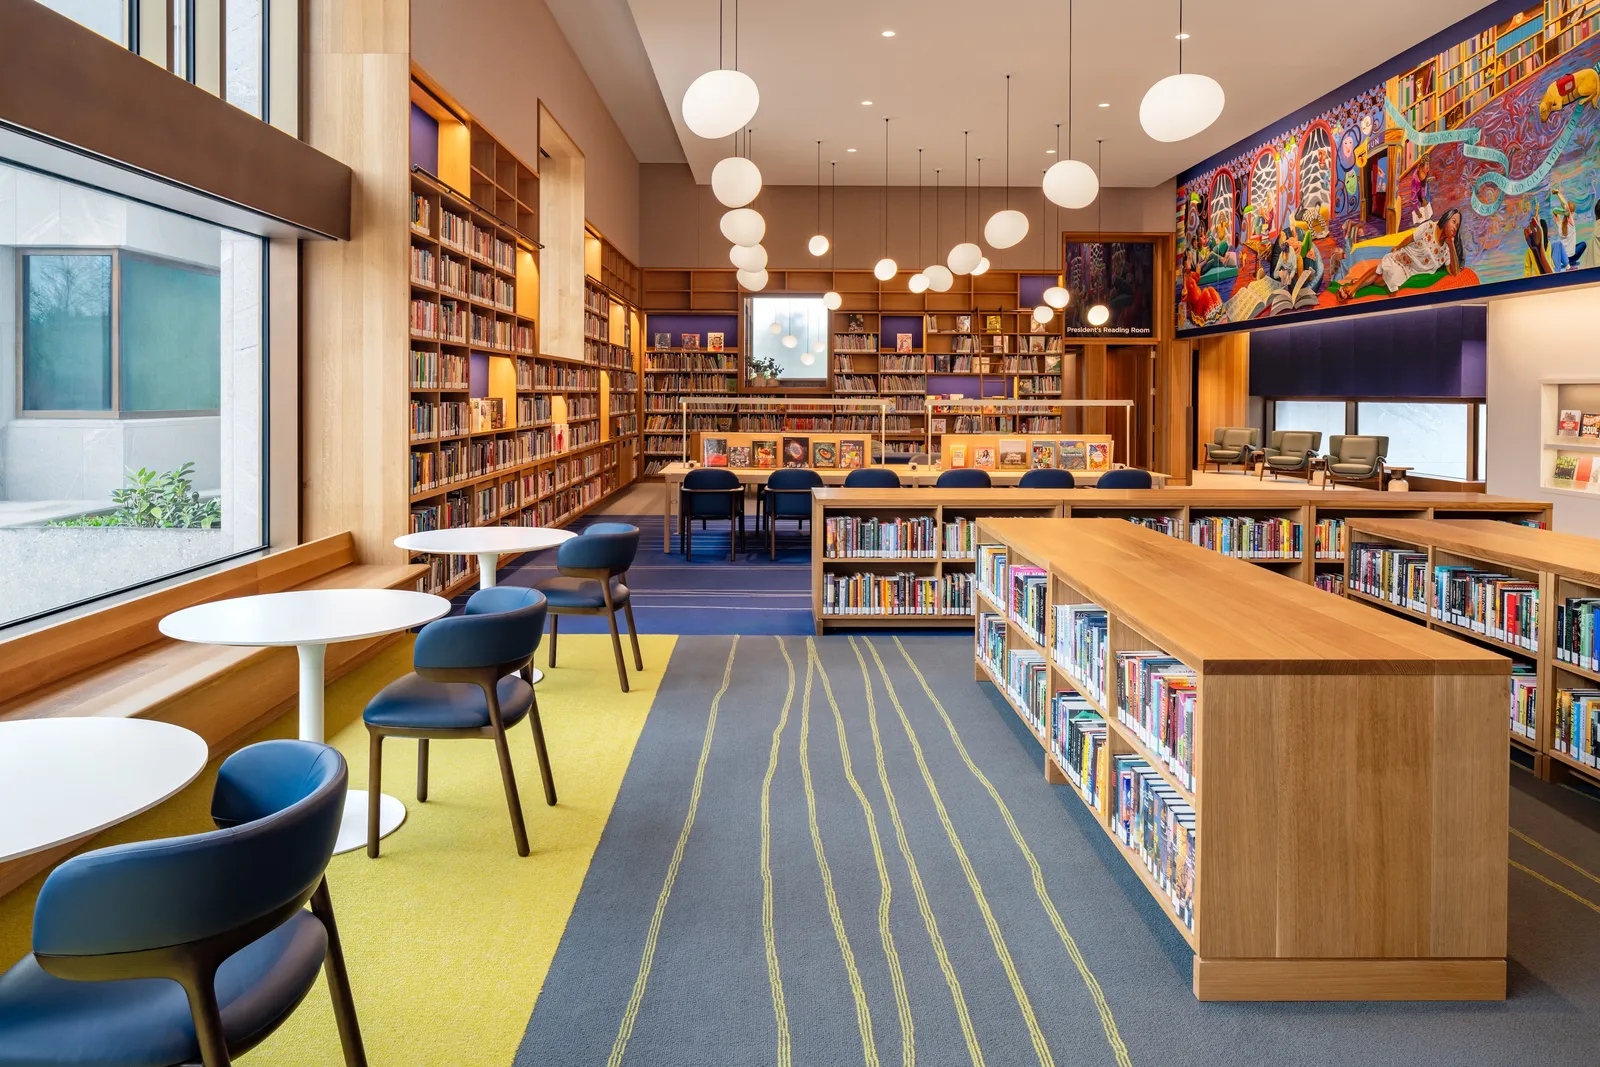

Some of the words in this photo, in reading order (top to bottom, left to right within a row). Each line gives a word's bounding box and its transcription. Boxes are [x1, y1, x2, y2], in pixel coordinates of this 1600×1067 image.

[1367, 138, 1380, 150] FUN
[1527, 169, 1544, 187] GIVE
[1546, 138, 1567, 166] VOICE
[1568, 118, 1577, 131] TO
